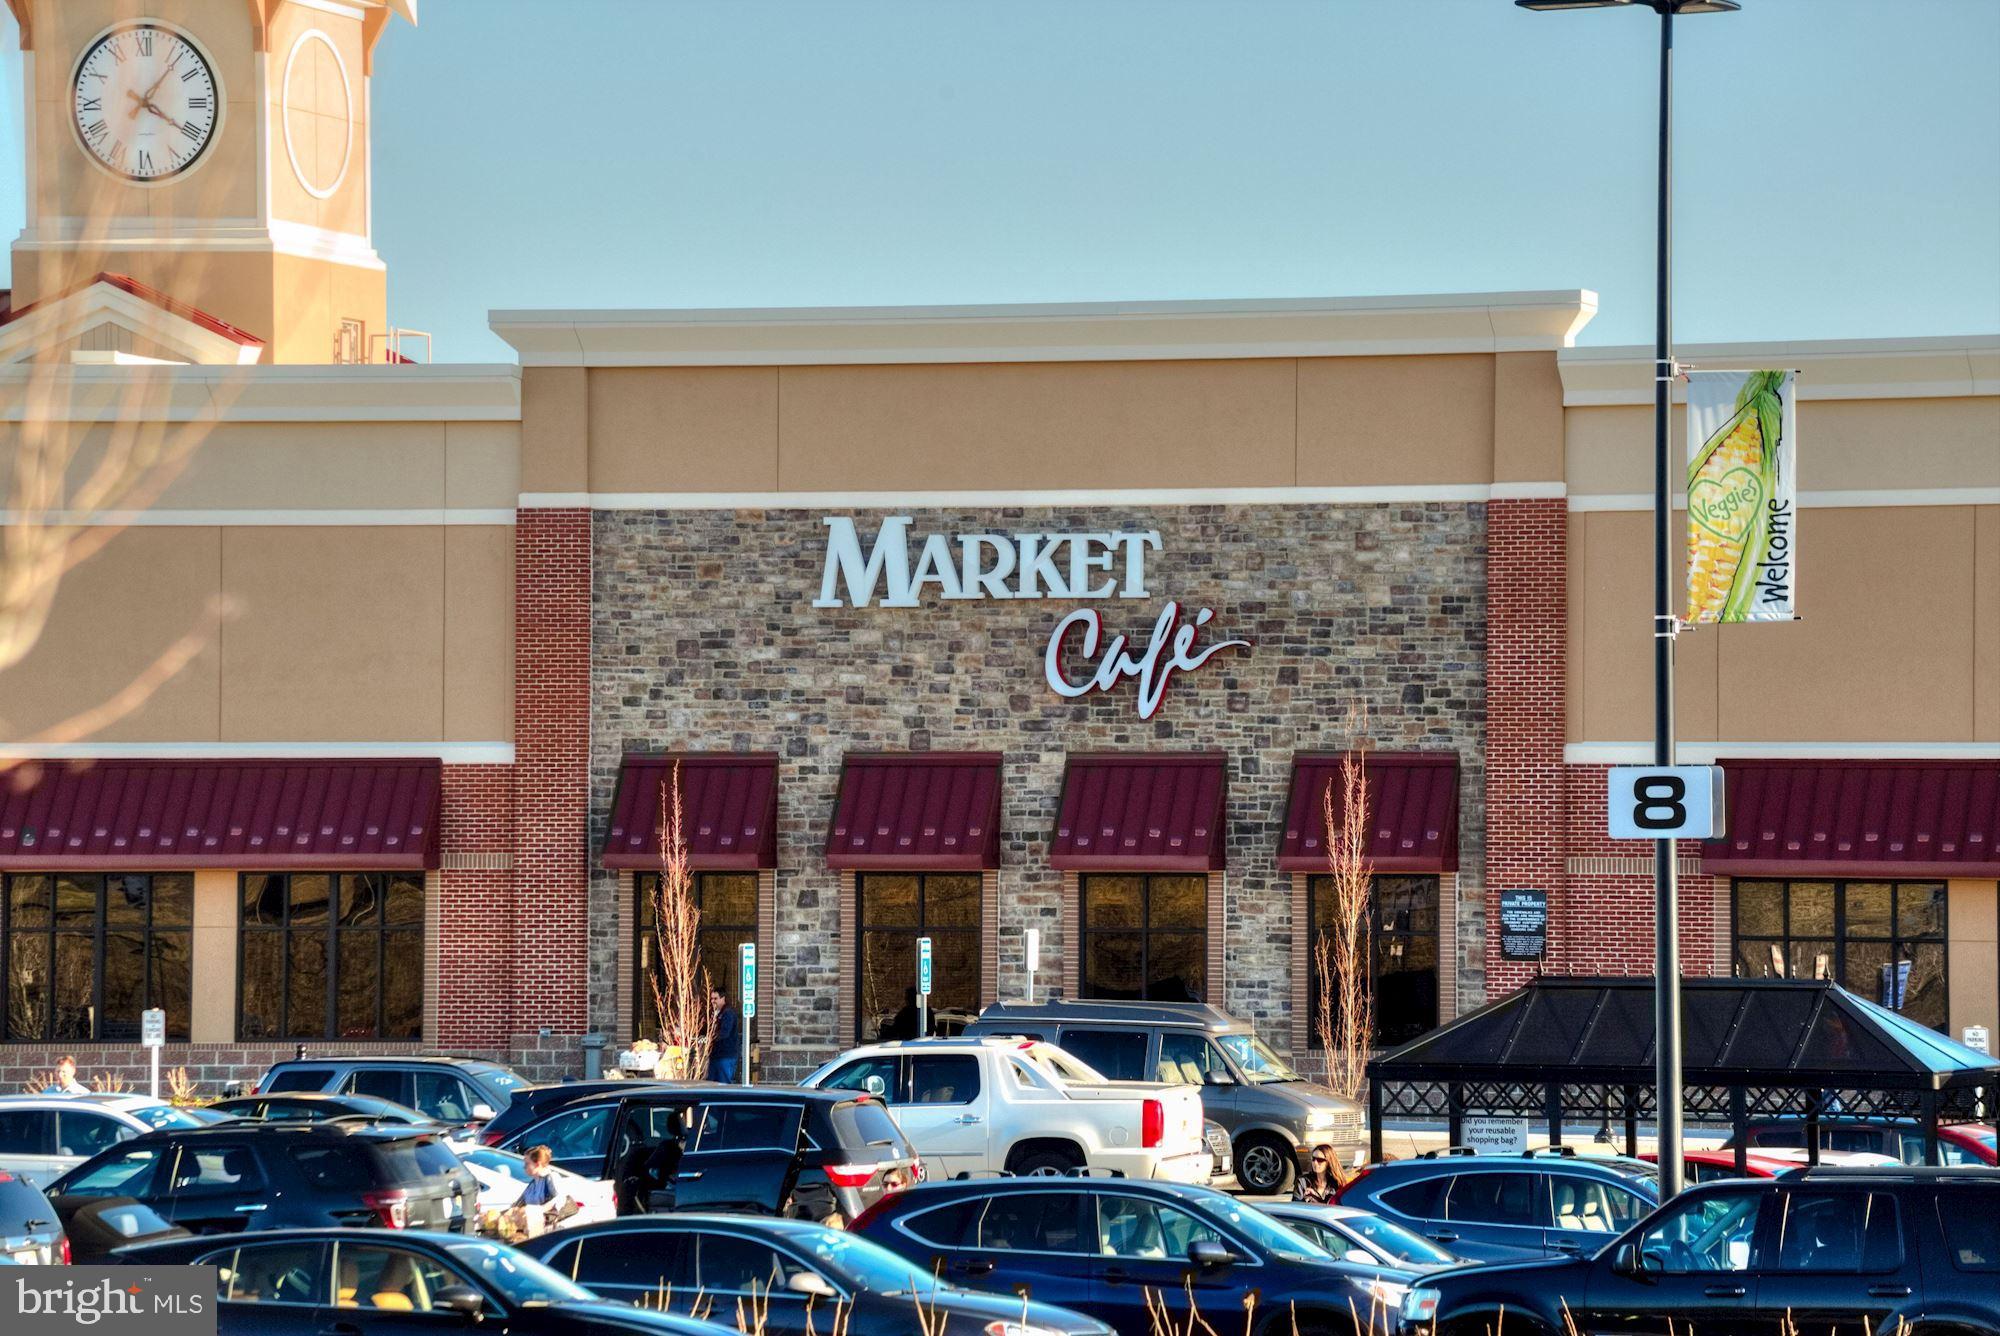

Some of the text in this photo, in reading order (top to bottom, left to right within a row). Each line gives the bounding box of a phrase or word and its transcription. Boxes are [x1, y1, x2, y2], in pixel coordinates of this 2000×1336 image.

[135, 37, 152, 57] XII
[181, 67, 200, 82] II
[188, 98, 207, 109] III
[1692, 478, 1758, 524] Veggies
[812, 516, 1163, 608] MARKET
[1755, 498, 1792, 604] Welcome
[1044, 600, 1254, 720] Café
[1633, 776, 1686, 829] 8
[1466, 1136, 1518, 1145] shopping bag?
